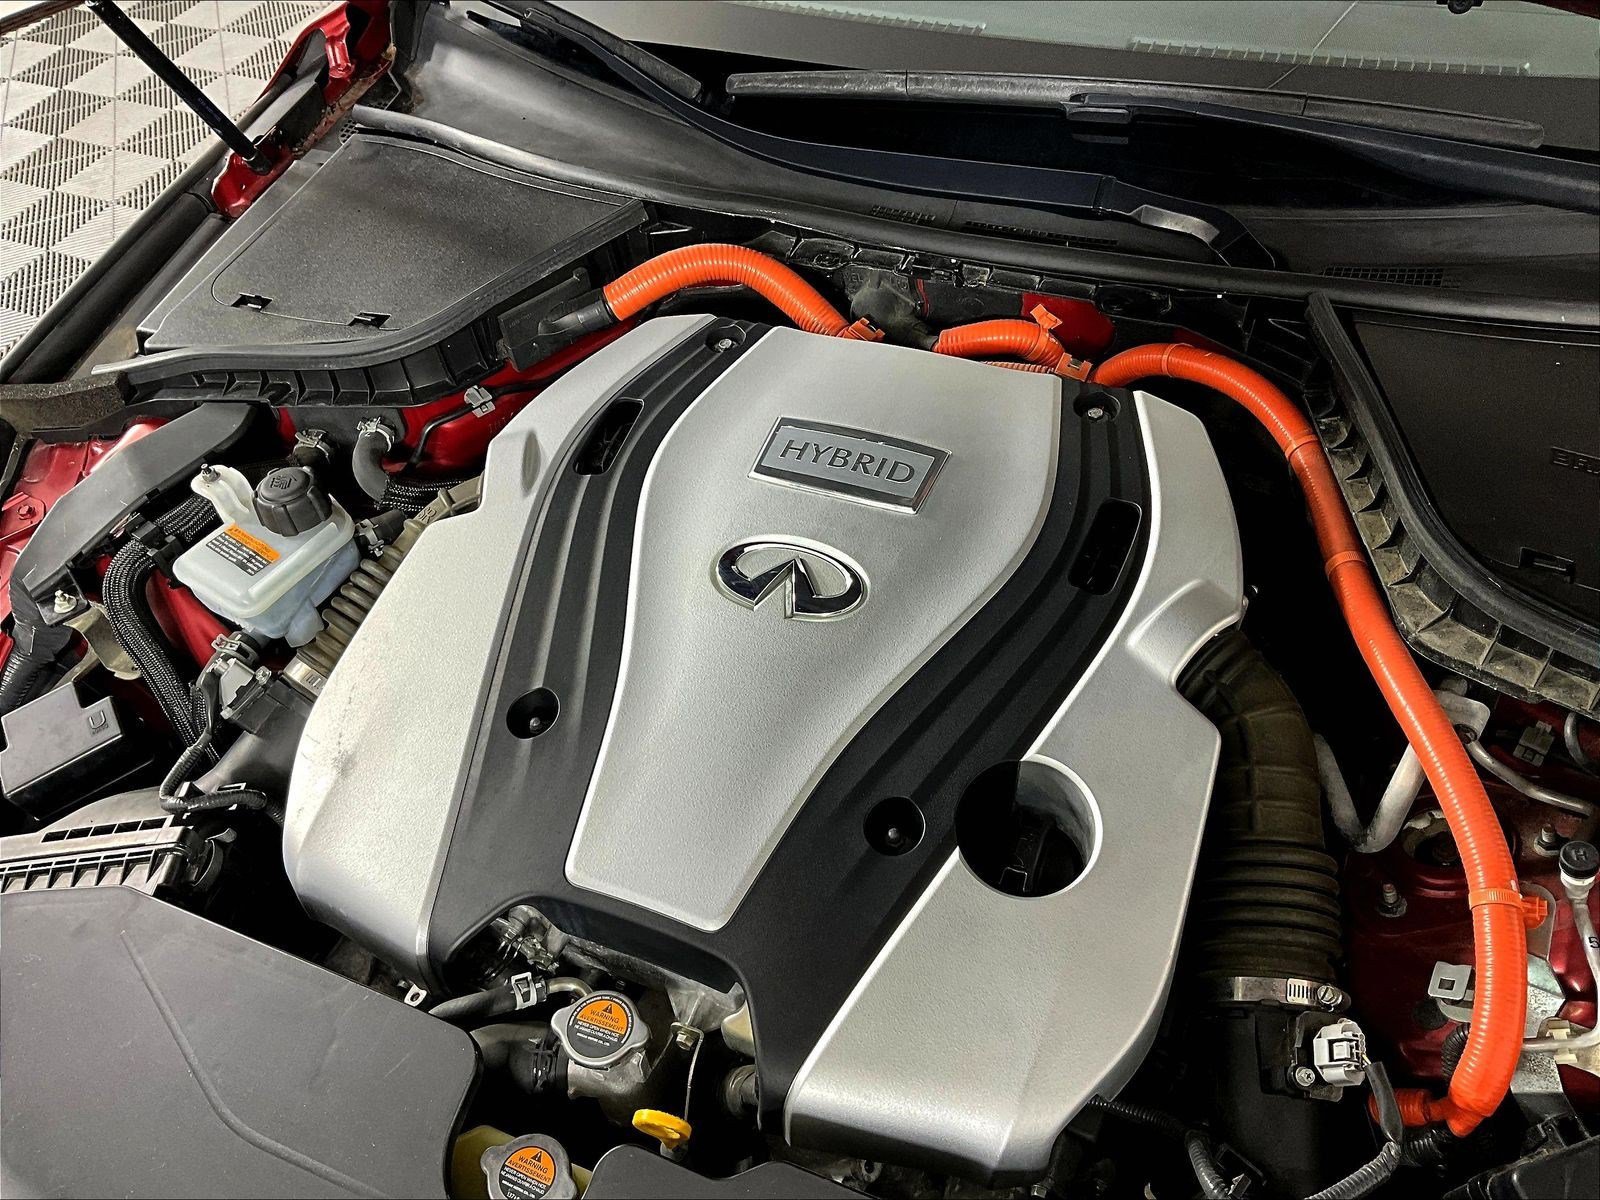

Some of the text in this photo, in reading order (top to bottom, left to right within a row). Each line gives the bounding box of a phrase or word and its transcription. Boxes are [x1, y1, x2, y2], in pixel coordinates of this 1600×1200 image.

[779, 439, 915, 483] HYBRID
[580, 1014, 624, 1032] AVERTISSEMENT
[590, 1009, 620, 1023] WARNING
[508, 1159, 551, 1183] AVERTISSEMENT
[519, 1155, 548, 1174] WARNING
